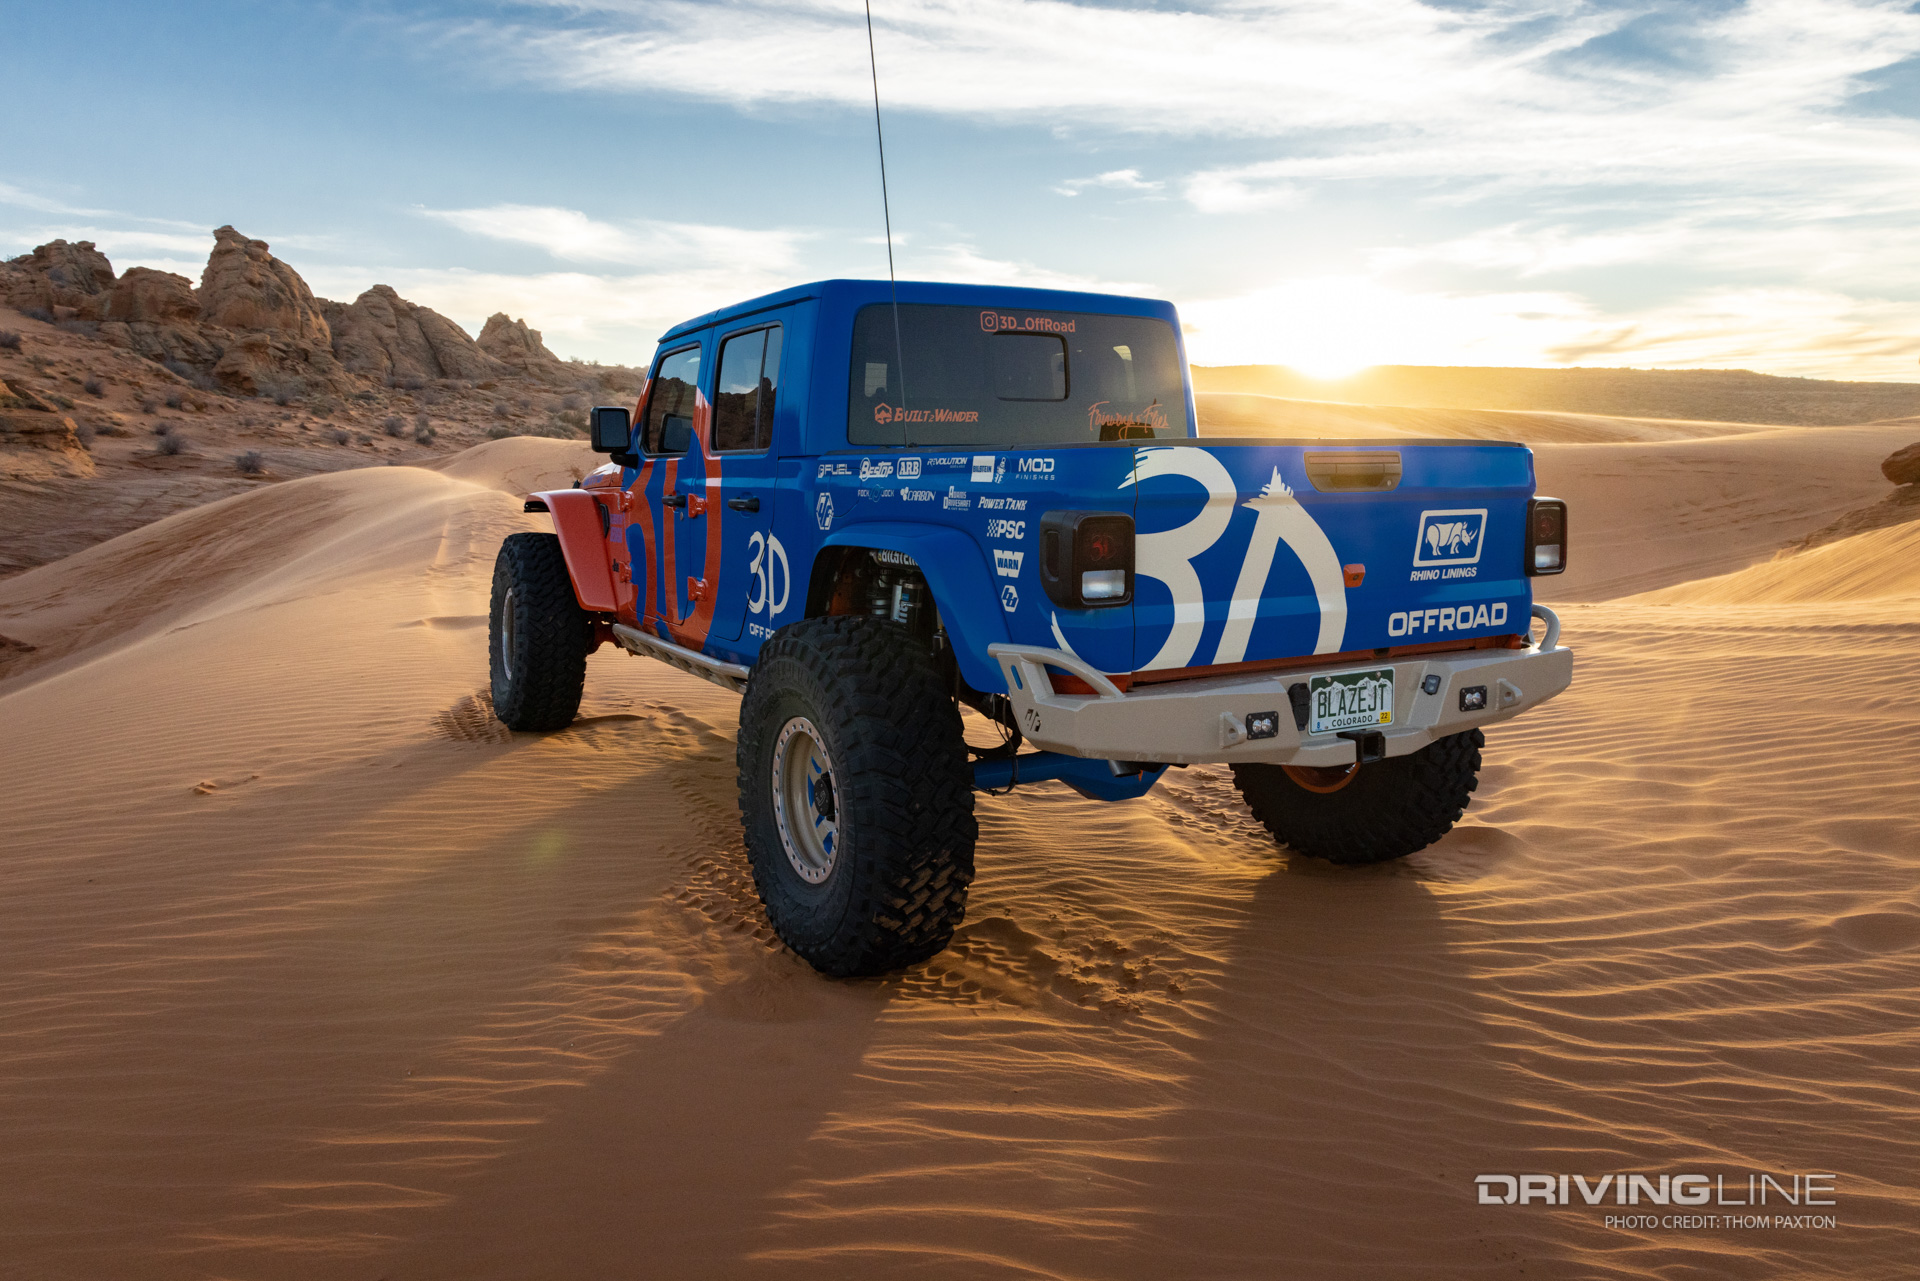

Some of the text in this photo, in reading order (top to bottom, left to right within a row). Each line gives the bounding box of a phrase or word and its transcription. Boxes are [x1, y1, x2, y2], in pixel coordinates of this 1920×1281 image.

[1000, 315, 1076, 333] 3D_OffRoad
[824, 463, 853, 476] FUEL
[899, 461, 920, 476] ARB
[926, 456, 969, 468] REVOLUTION
[1018, 457, 1056, 473] MOD
[907, 490, 937, 502] CARBON
[978, 496, 1028, 511] POWER TANK
[997, 519, 1026, 540] PSC
[997, 557, 1019, 571] WARN
[746, 529, 790, 621] 3D
[1410, 567, 1478, 582] RHINO LININGS
[1388, 602, 1508, 637] OFFROAD
[1317, 683, 1388, 719] BLAZEJT
[1331, 714, 1374, 727] COLORADO
[1380, 712, 1389, 720] 22
